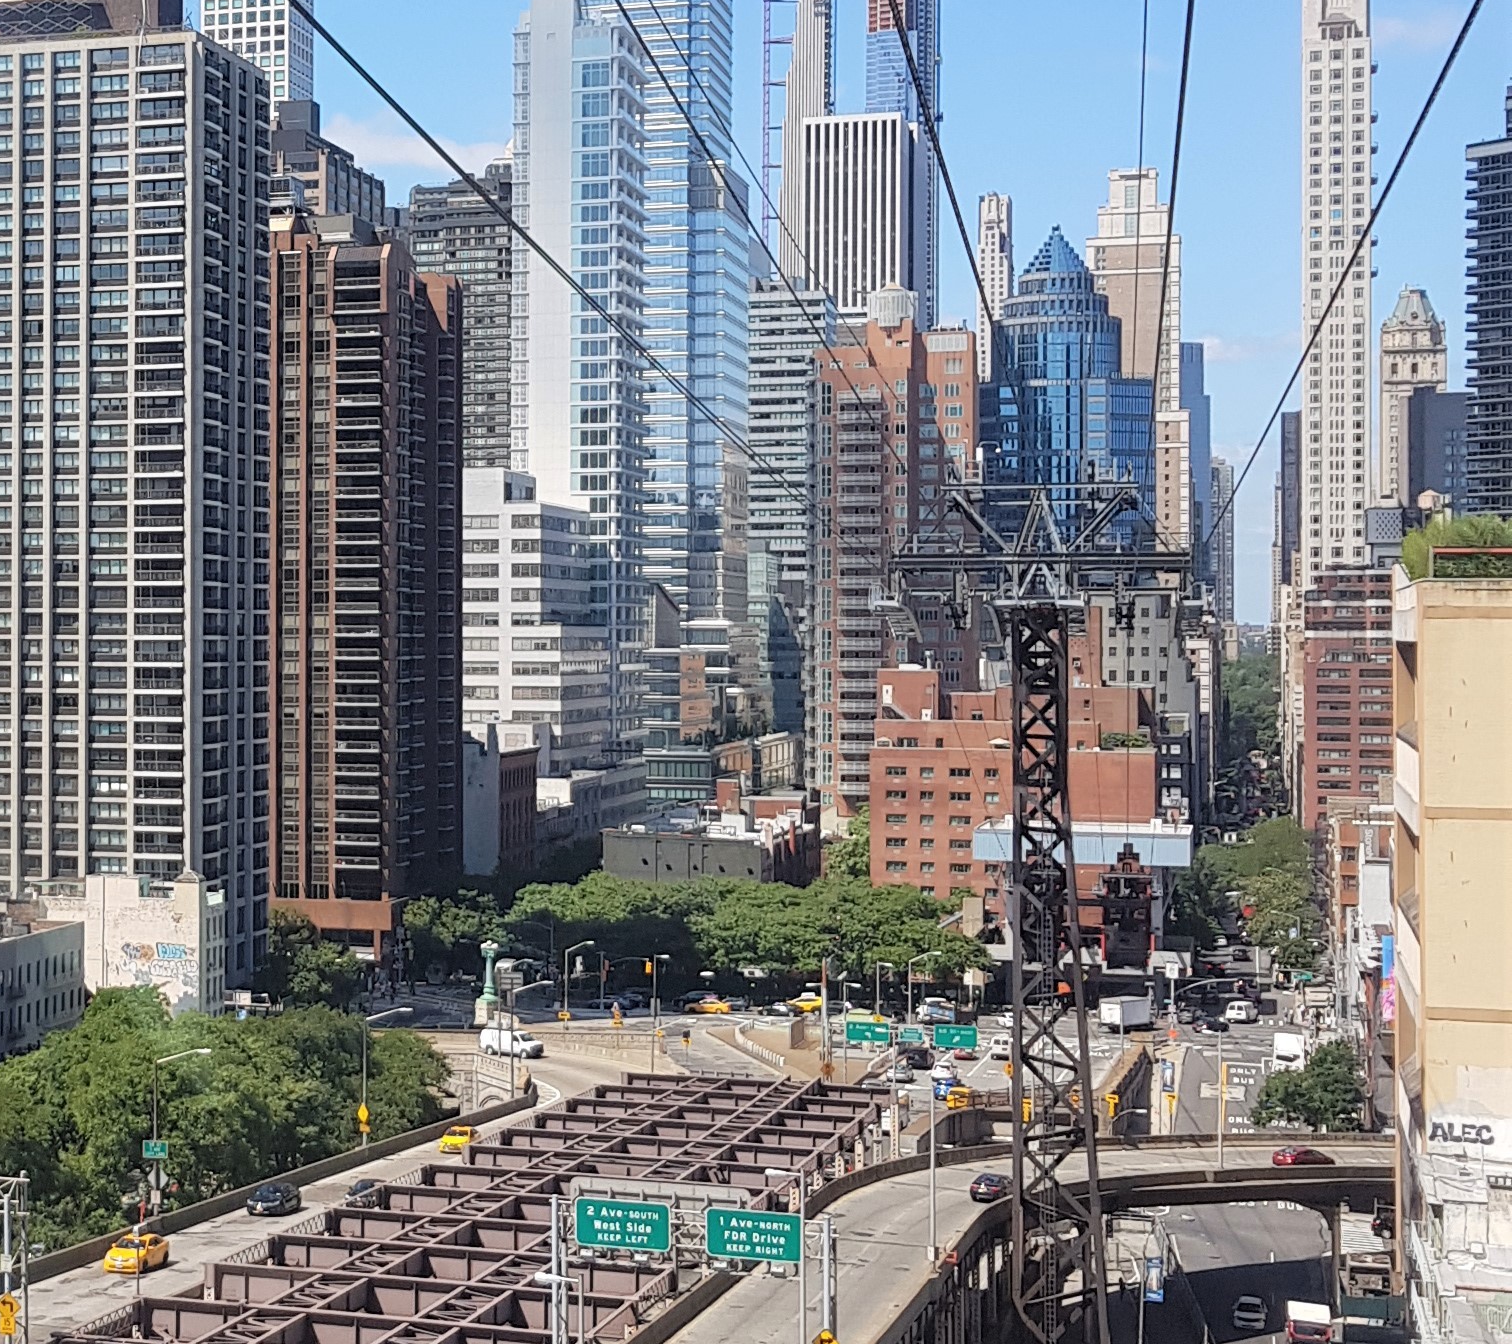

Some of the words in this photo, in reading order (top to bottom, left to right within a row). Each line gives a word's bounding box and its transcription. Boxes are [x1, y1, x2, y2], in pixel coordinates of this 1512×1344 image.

[586, 1205, 595, 1216] 2
[593, 1220, 621, 1231] West
[626, 1222, 652, 1233] Side
[719, 1216, 724, 1226] 1
[597, 1233, 621, 1242] KEEP
[625, 1235, 648, 1244] LEFT
[724, 1230, 747, 1241] FDR
[752, 1232, 786, 1245] Drive
[726, 1244, 751, 1252] KEEP
[755, 1246, 784, 1255] RIGHT
[3, 1318, 11, 1327] 15
